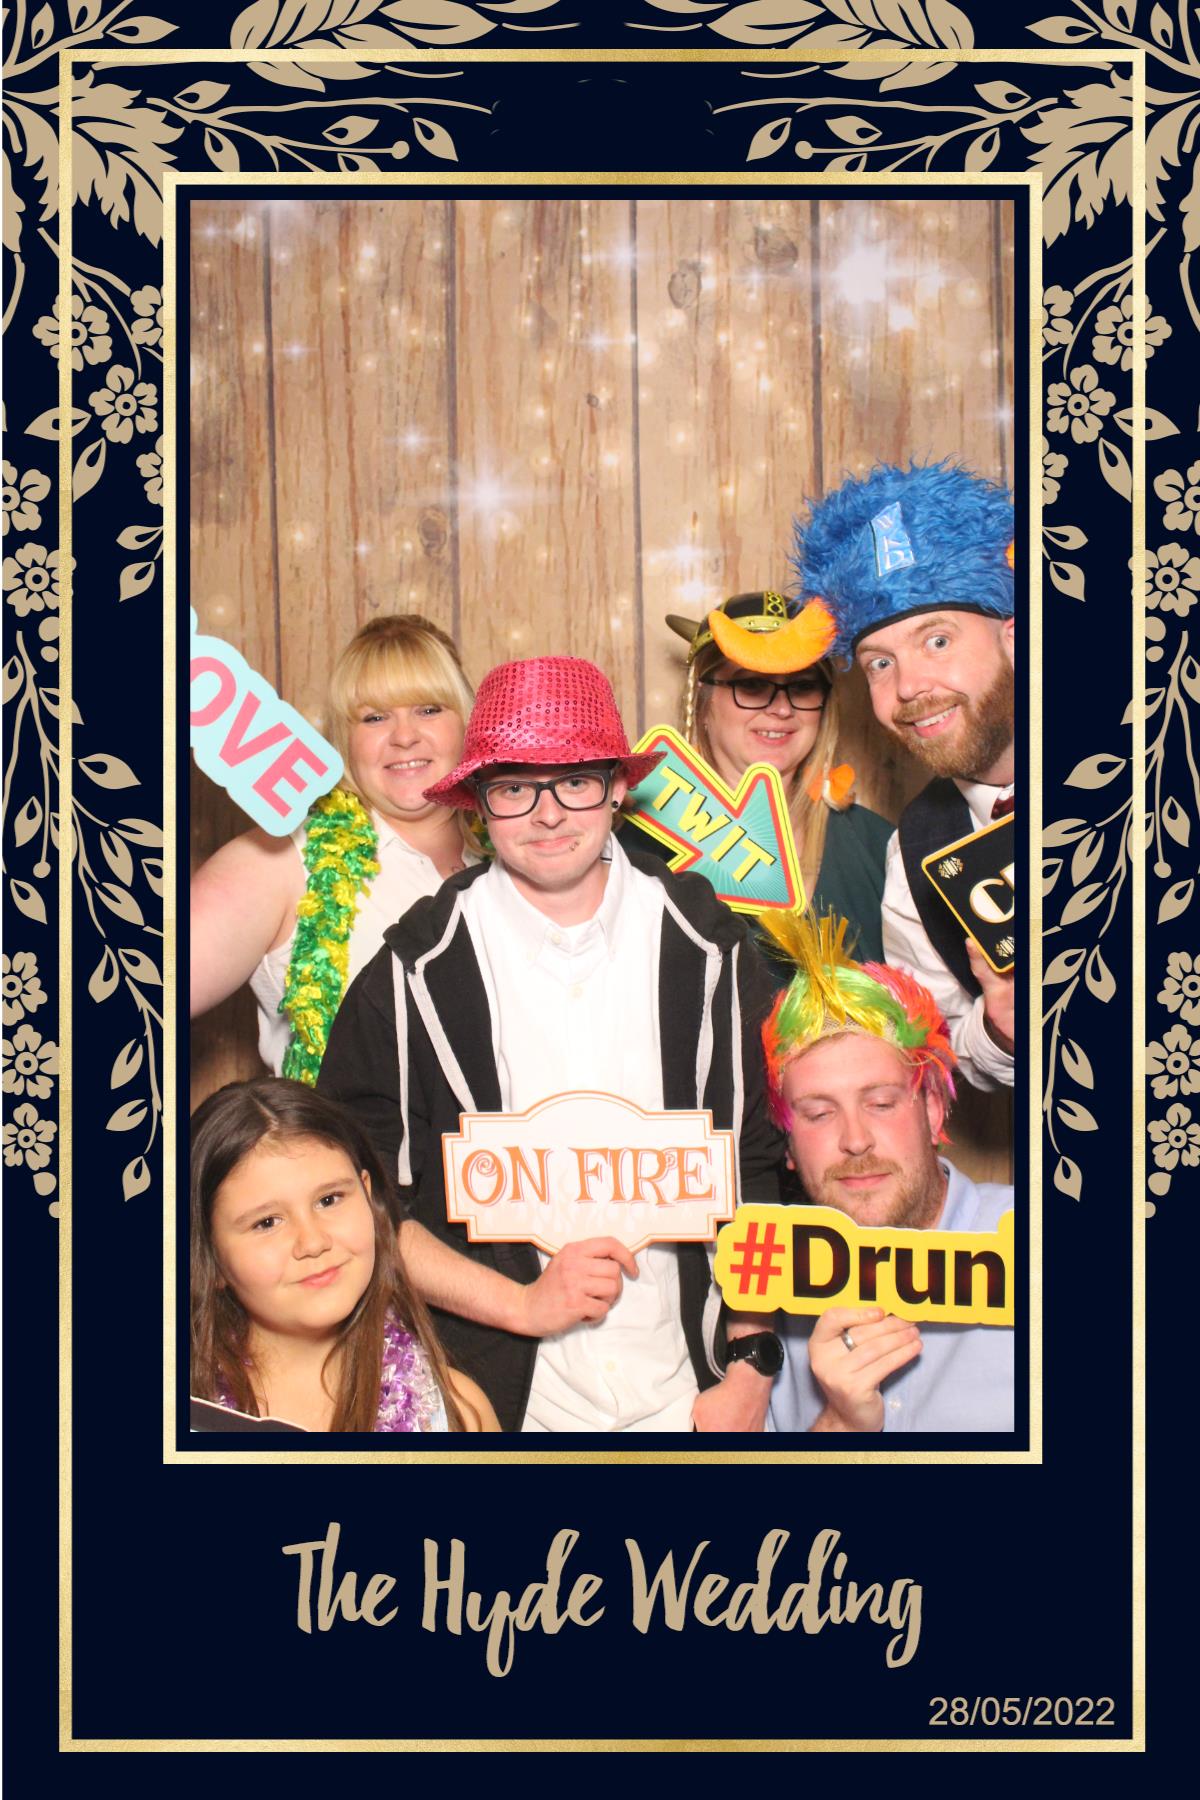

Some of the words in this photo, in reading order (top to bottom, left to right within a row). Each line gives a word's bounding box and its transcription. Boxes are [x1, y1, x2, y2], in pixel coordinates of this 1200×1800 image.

[651, 765, 777, 883] TWIT
[461, 1146, 553, 1206] ON
[568, 1145, 716, 1207] FIRE
